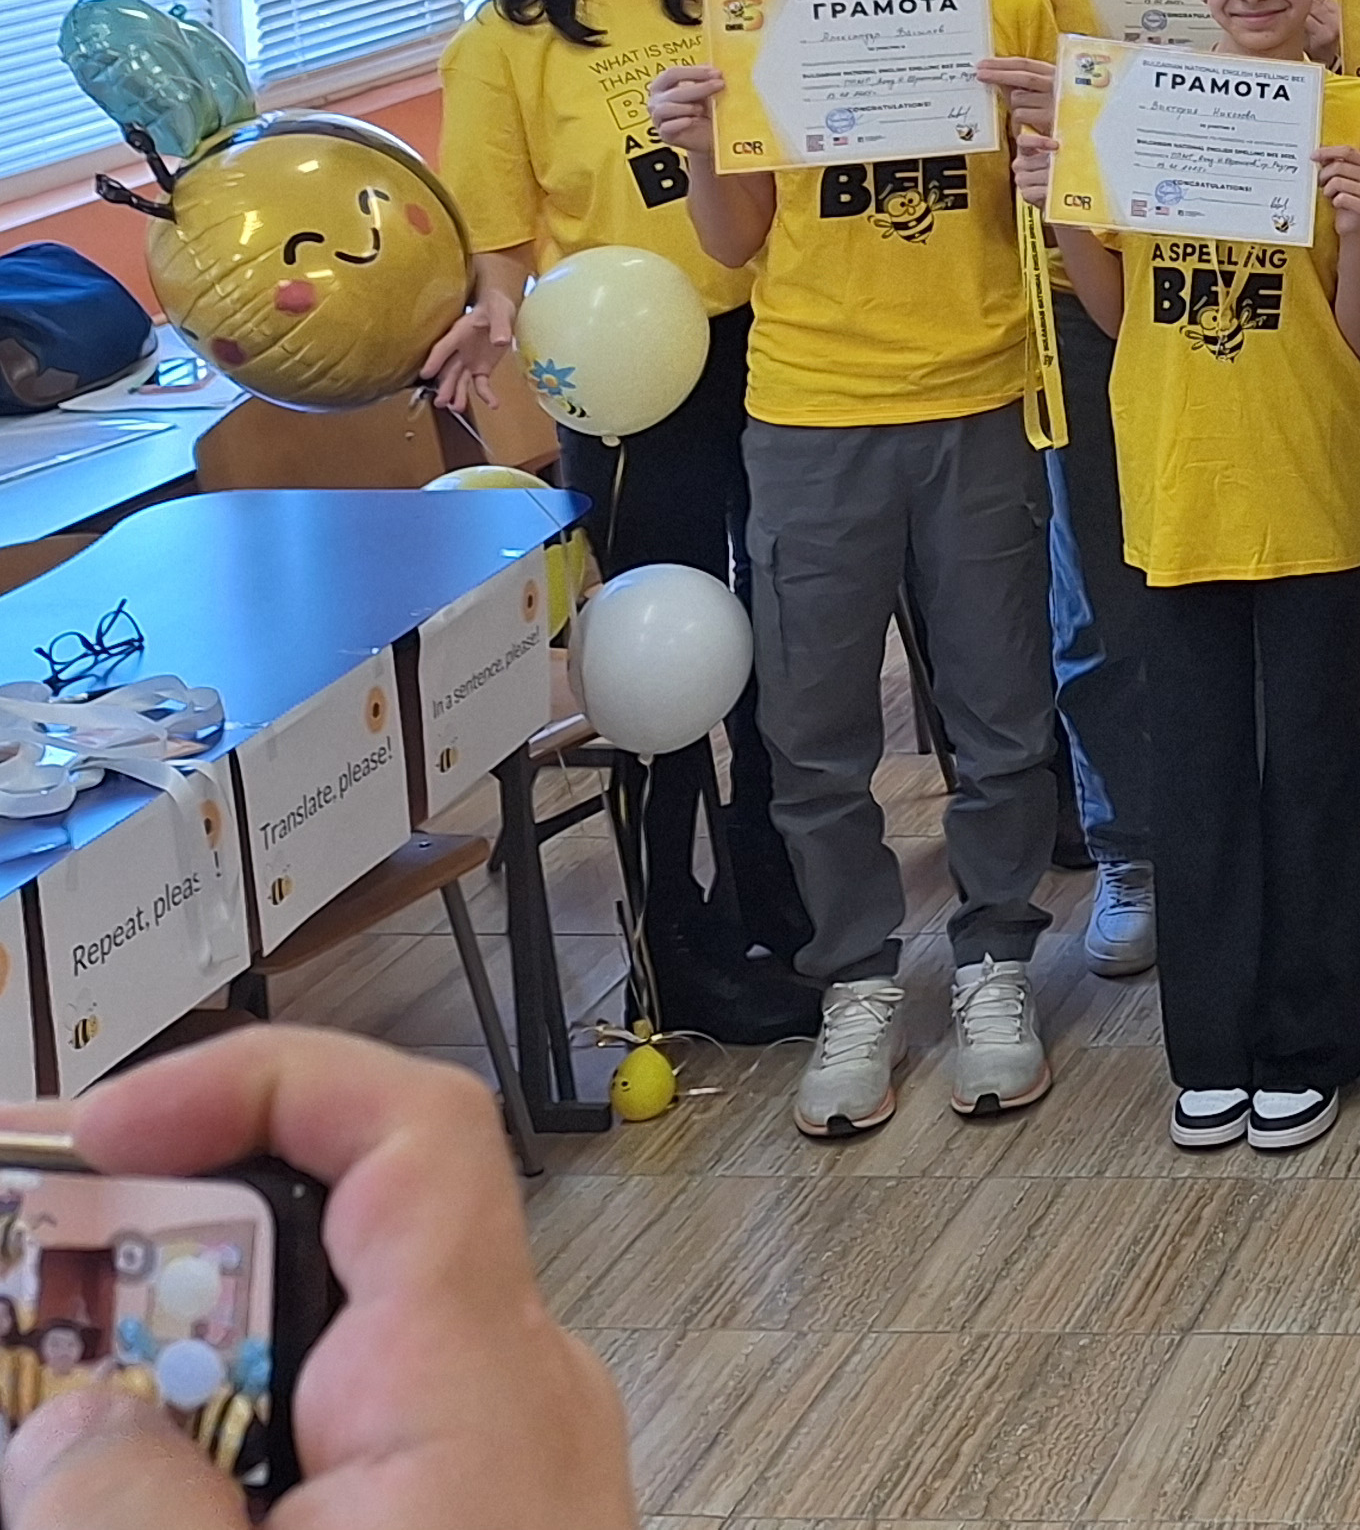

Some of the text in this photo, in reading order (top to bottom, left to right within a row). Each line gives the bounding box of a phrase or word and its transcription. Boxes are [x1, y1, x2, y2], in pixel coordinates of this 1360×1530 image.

[589, 44, 661, 75] WHAT IS
[599, 62, 666, 92] THAN A
[1155, 72, 1290, 101] ГРАМОТА
[625, 135, 643, 154] A
[820, 155, 968, 218] BEE
[1152, 243, 1287, 268] A SPELLING
[1153, 266, 1284, 330] BEE
[433, 700, 444, 719] In
[445, 695, 452, 709] a
[259, 736, 393, 850] Translate, please!
[73, 851, 222, 976] Repeat, pleas!
